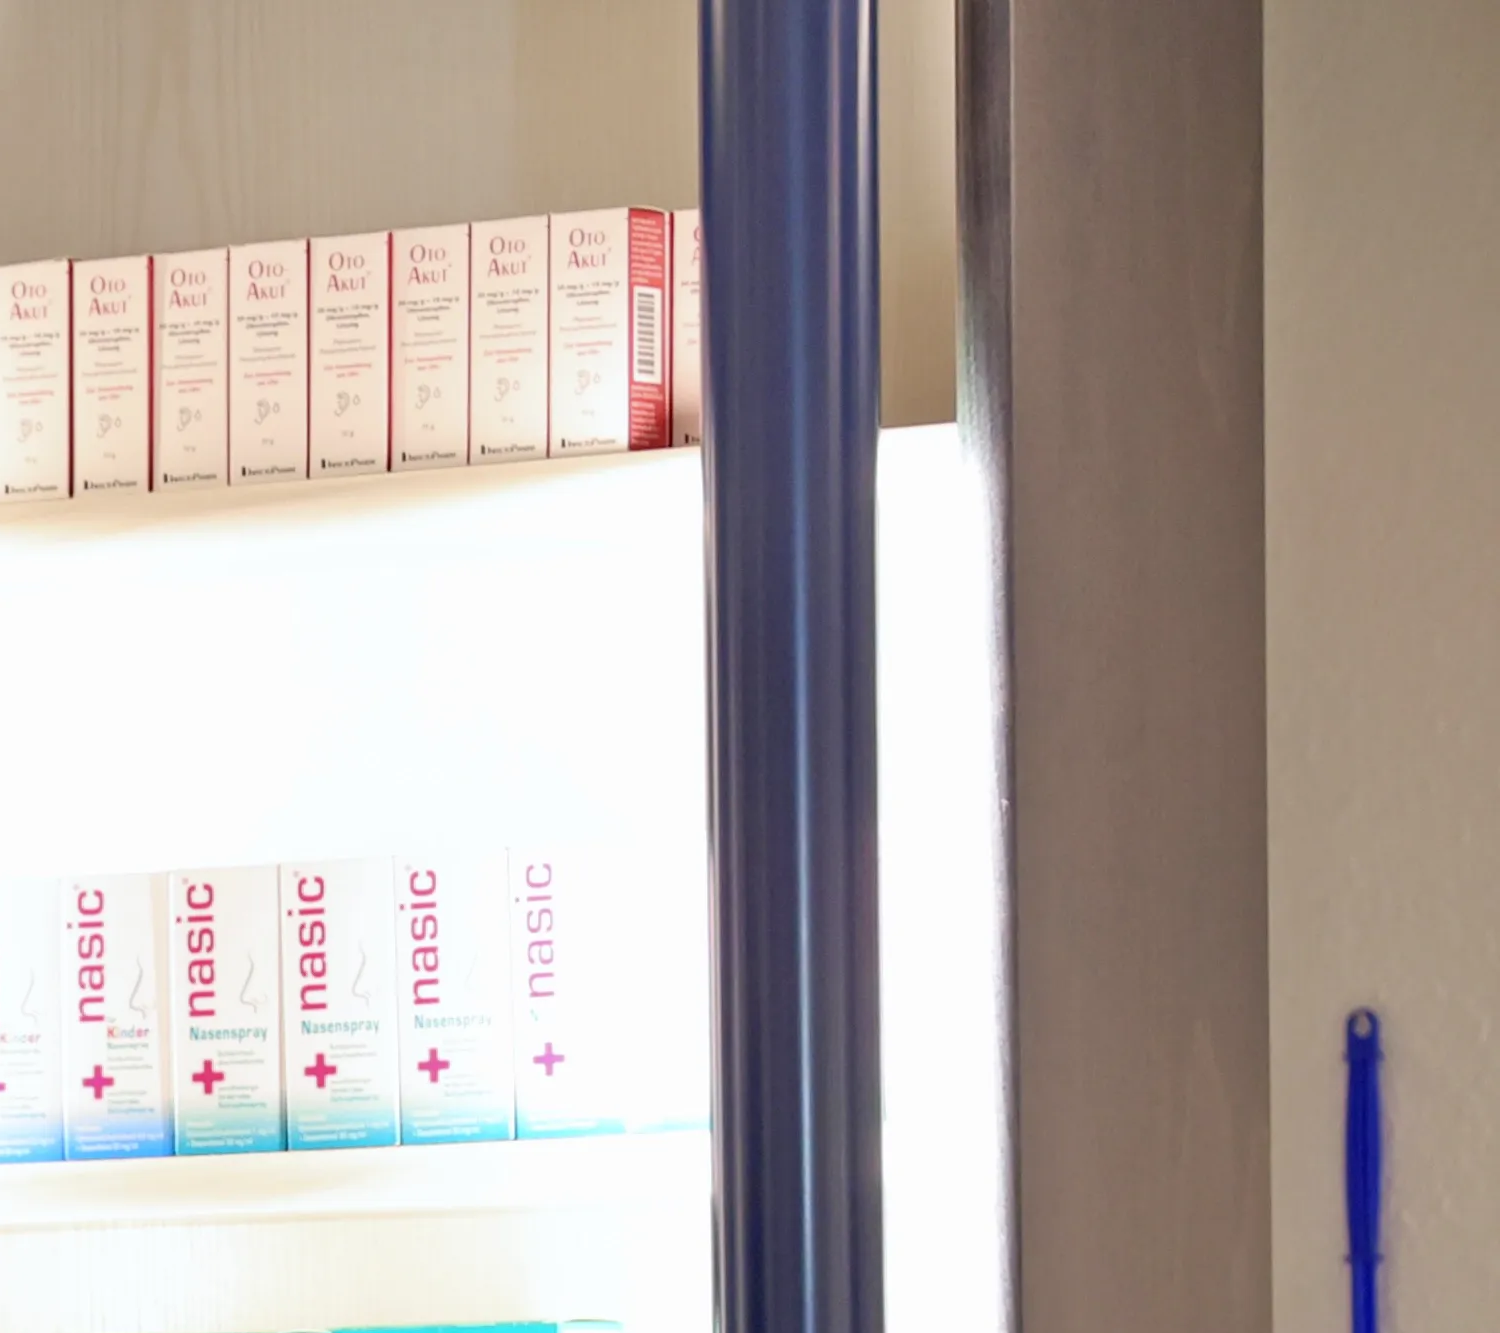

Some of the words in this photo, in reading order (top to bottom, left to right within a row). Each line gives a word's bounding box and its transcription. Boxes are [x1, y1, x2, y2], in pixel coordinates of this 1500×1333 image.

[66, 889, 105, 1022] nasic
[175, 883, 216, 1018] nasic
[287, 876, 328, 1011] nasic
[399, 869, 441, 1005] nasic
[514, 863, 556, 998] nasic
[189, 1026, 268, 1044] Nasenspray
[301, 1018, 380, 1036] Nasenspray
